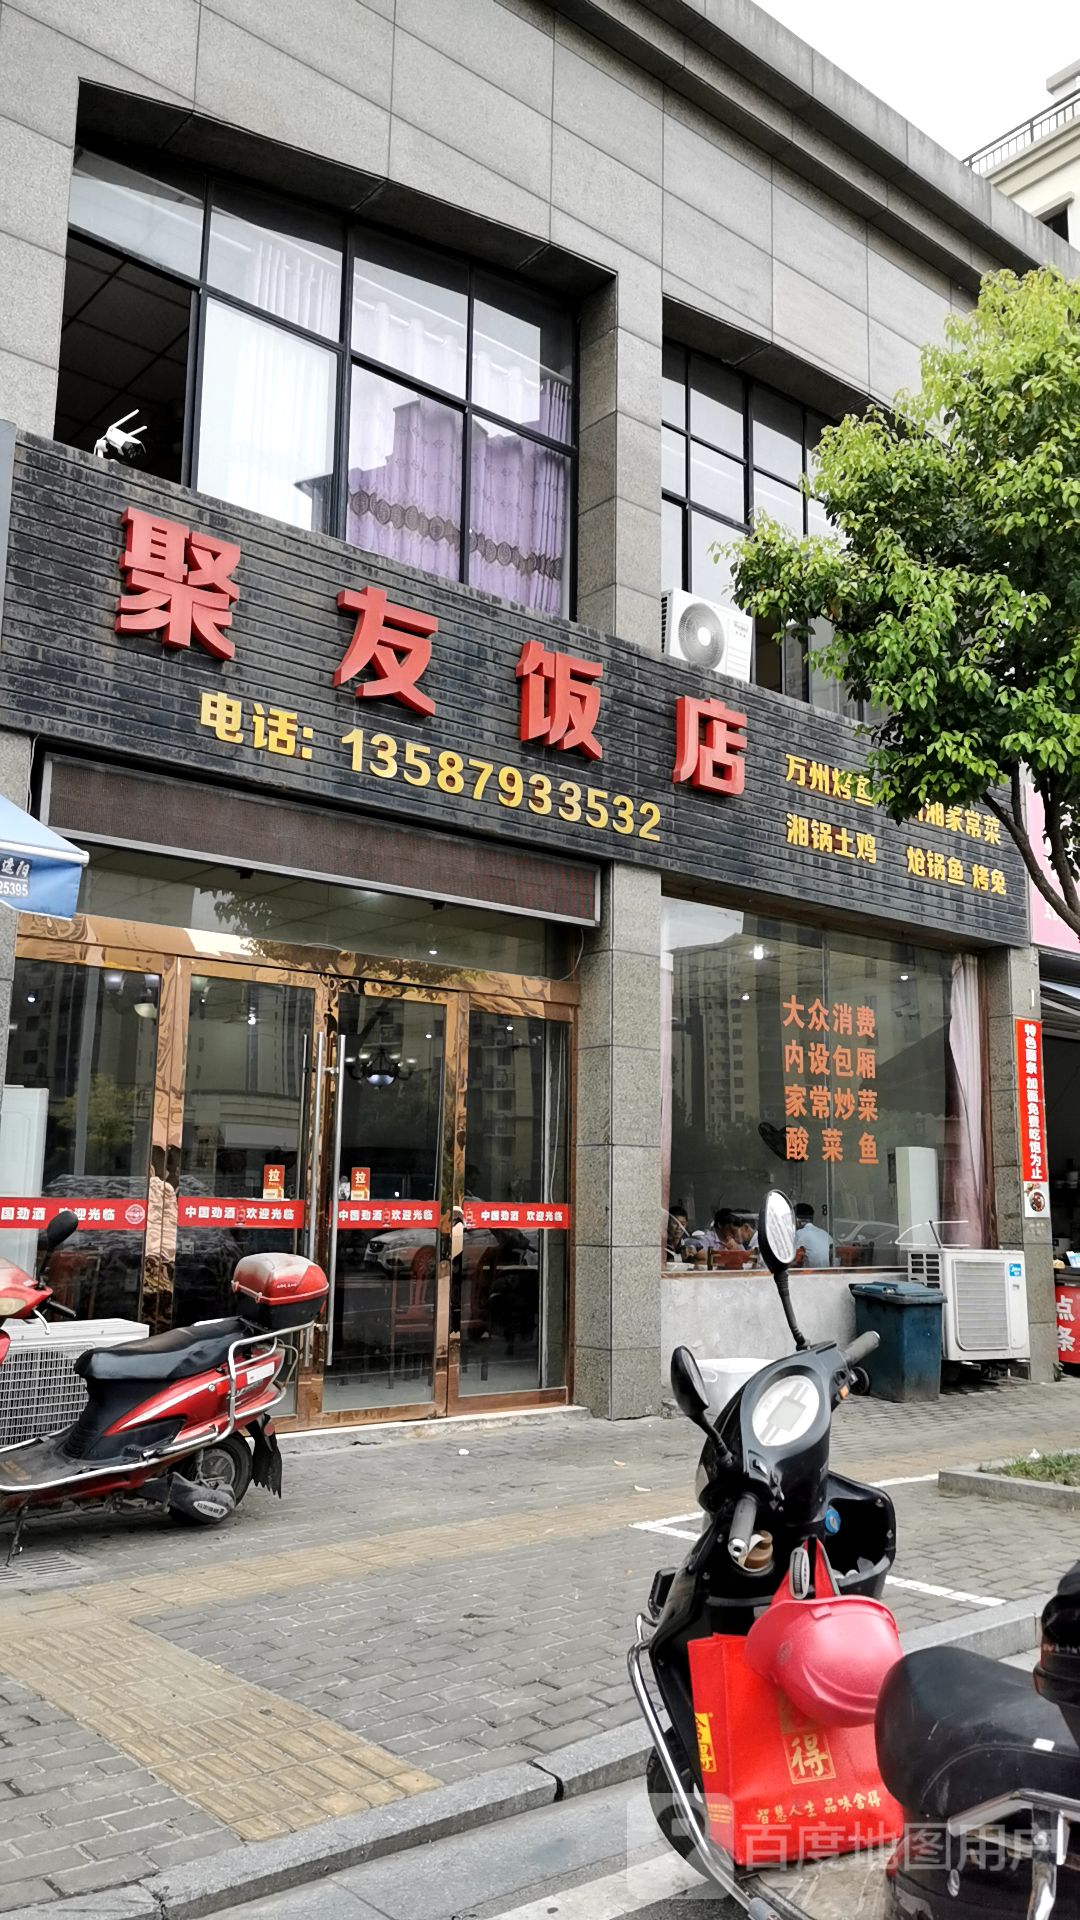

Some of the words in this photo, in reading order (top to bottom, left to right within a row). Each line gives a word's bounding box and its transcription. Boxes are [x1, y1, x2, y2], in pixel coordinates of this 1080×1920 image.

[115, 506, 748, 797] 聚友饭店
[786, 812, 877, 864] 湘锅土鸡
[915, 797, 1001, 846] 湘家常菜
[782, 994, 876, 1038] 大众消费
[784, 1039, 876, 1079] 内设包厢
[1024, 1023, 1038, 1074] 特色面条
[784, 1083, 879, 1122] 家常炒菜
[785, 1126, 880, 1165] 酸菜鱼
[185, 1206, 236, 1220] 中国劲酒
[246, 1208, 295, 1221] 欢迎光临
[338, 1209, 382, 1222] 中国劲酒
[391, 1209, 433, 1221] 欢迎光临
[481, 1210, 519, 1222] 中国劲酒
[526, 1210, 563, 1222] 欢迎光临
[791, 1734, 828, 1777] 得
[823, 1789, 881, 1814] 品味舍得
